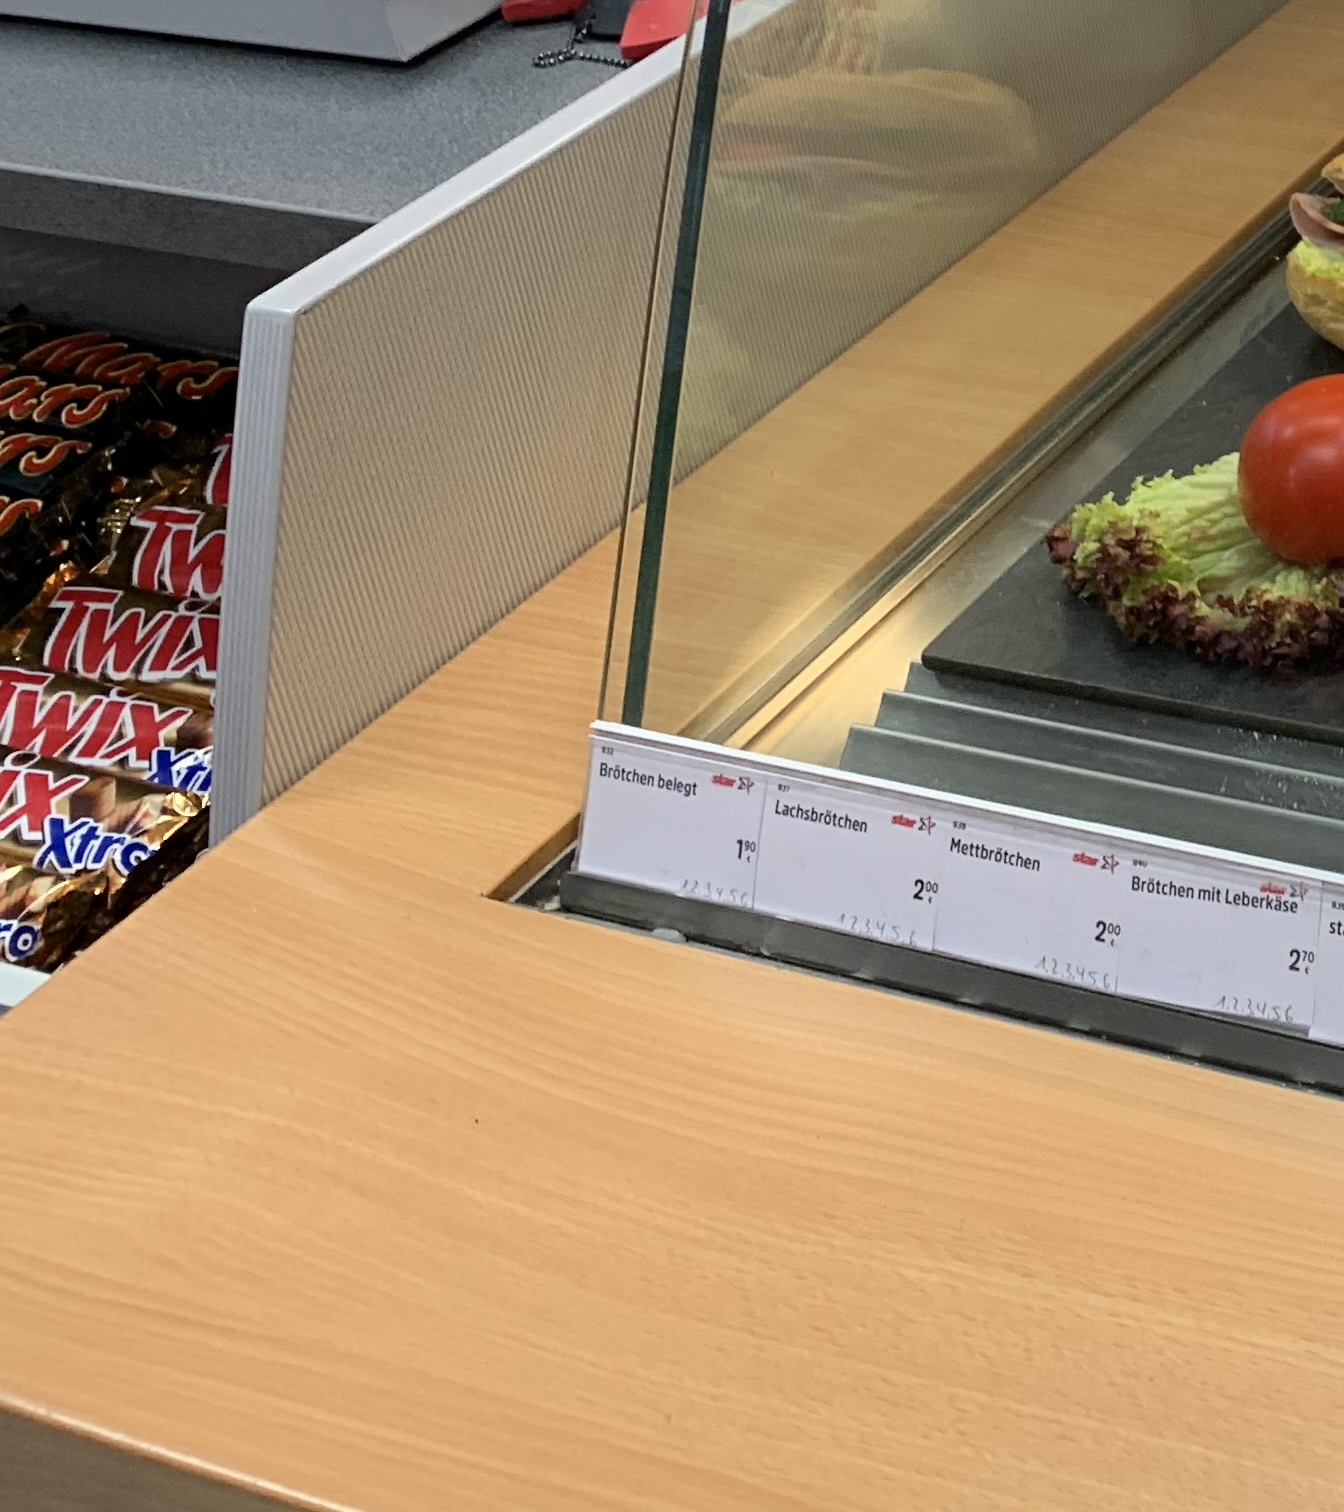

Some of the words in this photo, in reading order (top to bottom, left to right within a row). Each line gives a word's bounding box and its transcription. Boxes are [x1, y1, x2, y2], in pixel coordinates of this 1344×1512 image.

[599, 761, 656, 788] Brötchen
[657, 776, 698, 797] belegt
[774, 799, 869, 834] Lachsbrötchen
[949, 837, 1041, 872] Mettbrötchen
[1131, 875, 1195, 898] Brötchen
[1197, 886, 1222, 903] mit
[1224, 890, 1299, 915] Leberkäse
